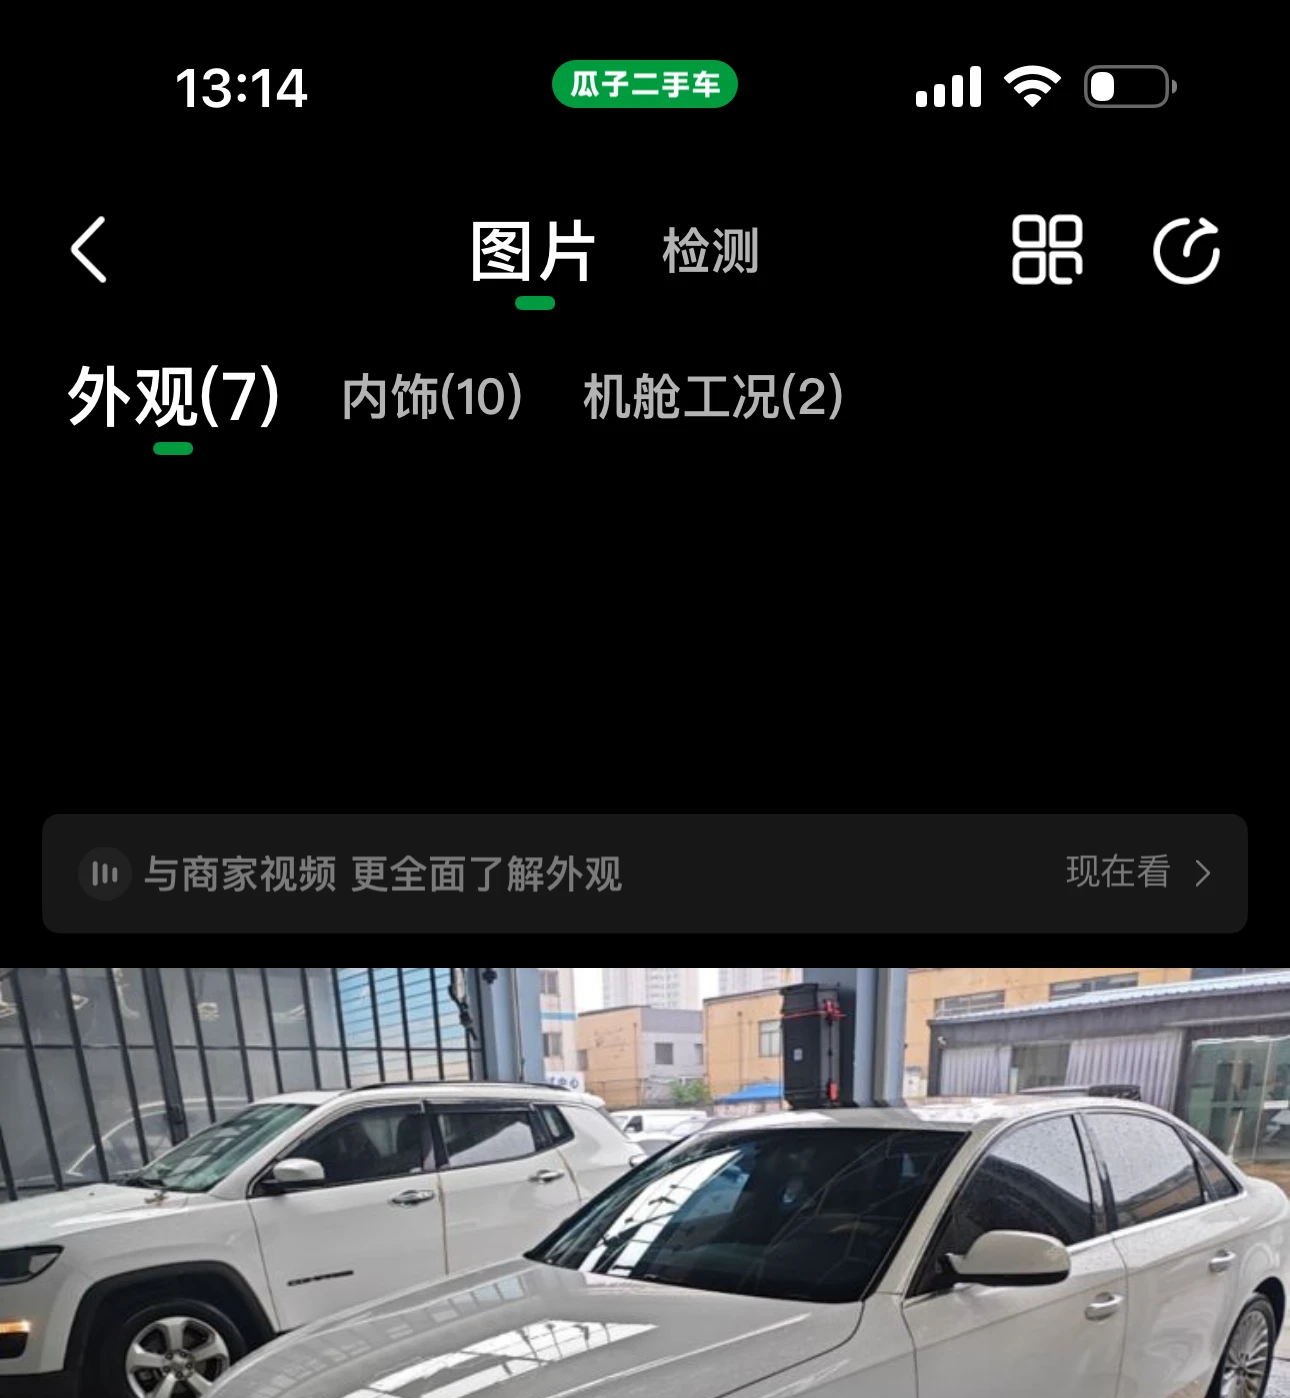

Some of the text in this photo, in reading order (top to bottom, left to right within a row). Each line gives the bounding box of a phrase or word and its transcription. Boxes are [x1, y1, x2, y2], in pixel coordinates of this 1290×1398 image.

[177, 68, 307, 108] 13:14
[571, 70, 721, 99] 瓜子二手车
[473, 219, 595, 281] 图片
[662, 227, 758, 273] 检测
[68, 365, 278, 427] 外观(7)
[344, 373, 521, 420] 内饰(10)
[584, 373, 842, 420] 机舱工况(2)
[145, 855, 623, 893] 与商家视频 更全面了解外观
[1066, 854, 1171, 888] 现在看
